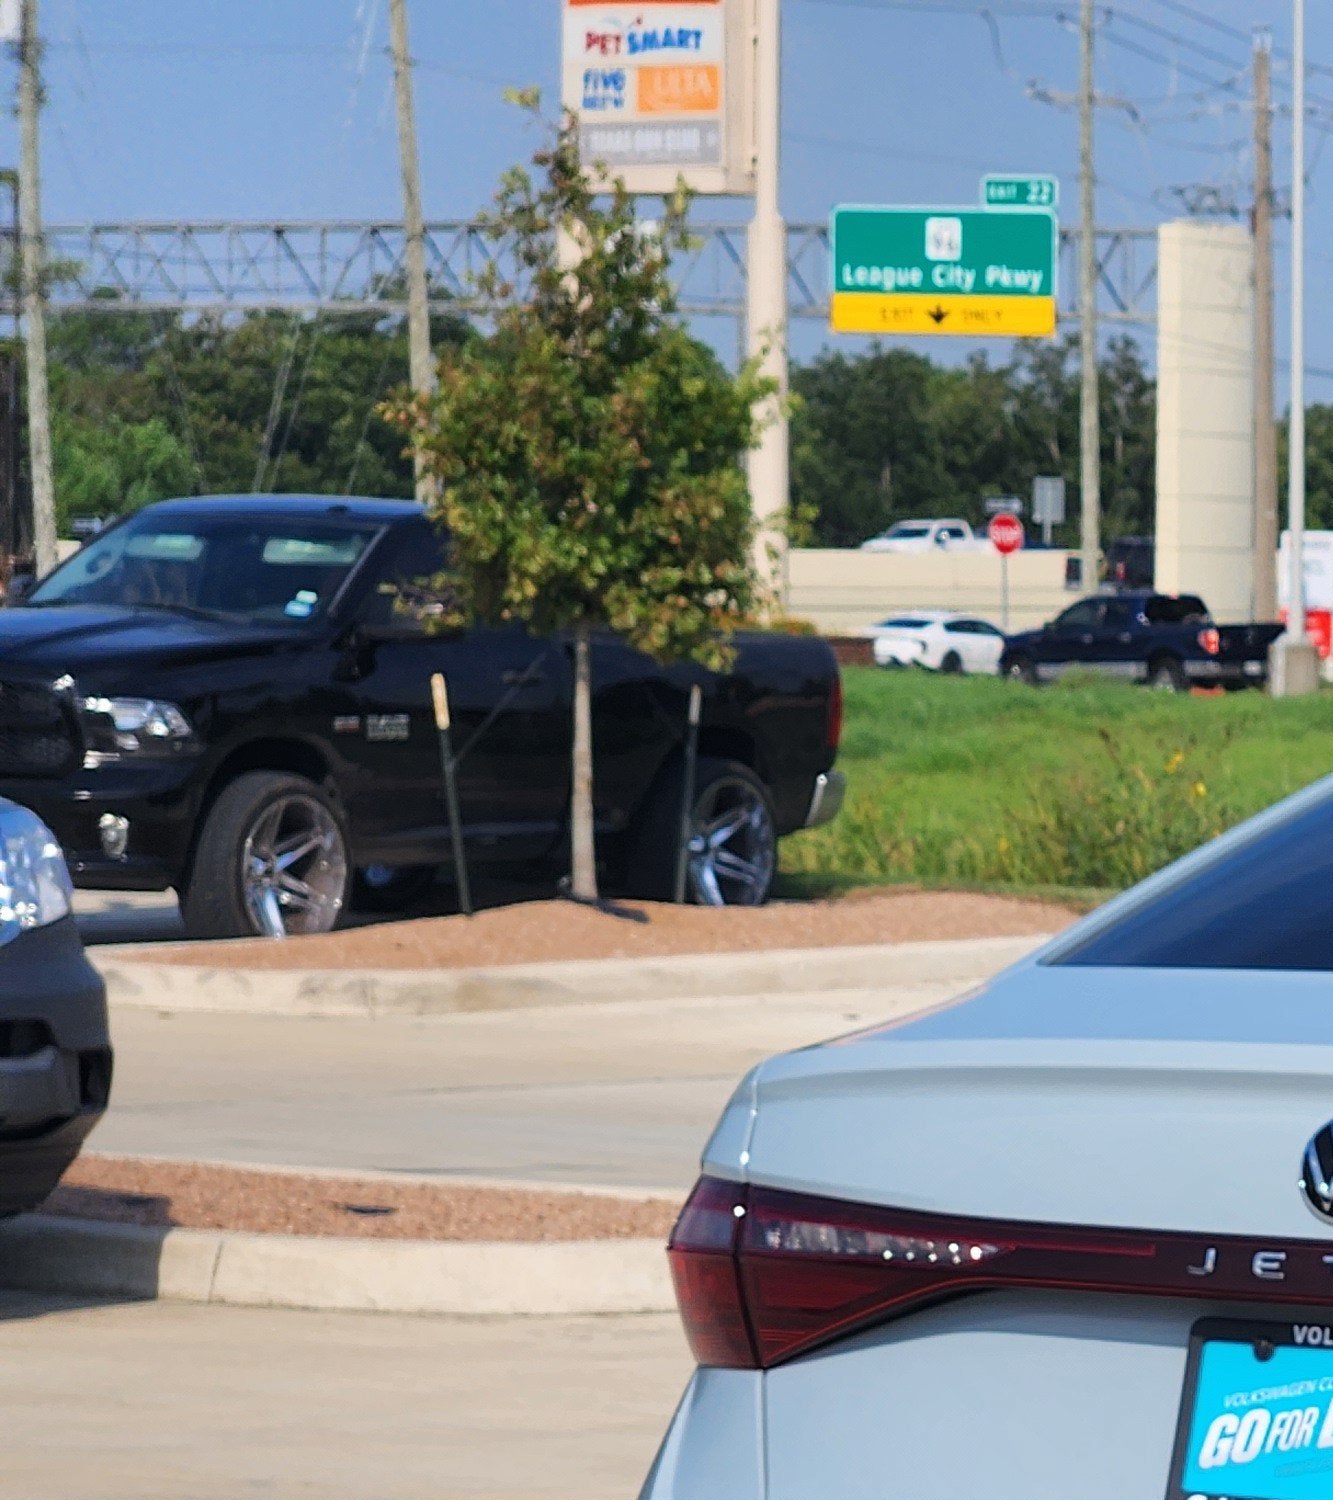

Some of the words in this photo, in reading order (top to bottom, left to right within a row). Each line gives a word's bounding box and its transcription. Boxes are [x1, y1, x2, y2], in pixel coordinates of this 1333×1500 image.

[841, 263, 923, 291] League
[932, 263, 976, 292] City
[985, 264, 1043, 294] Pkwy
[1224, 1379, 1316, 1409] VOLKSWAGEN
[1198, 1408, 1271, 1469] GO
[1265, 1406, 1319, 1453] FOR
